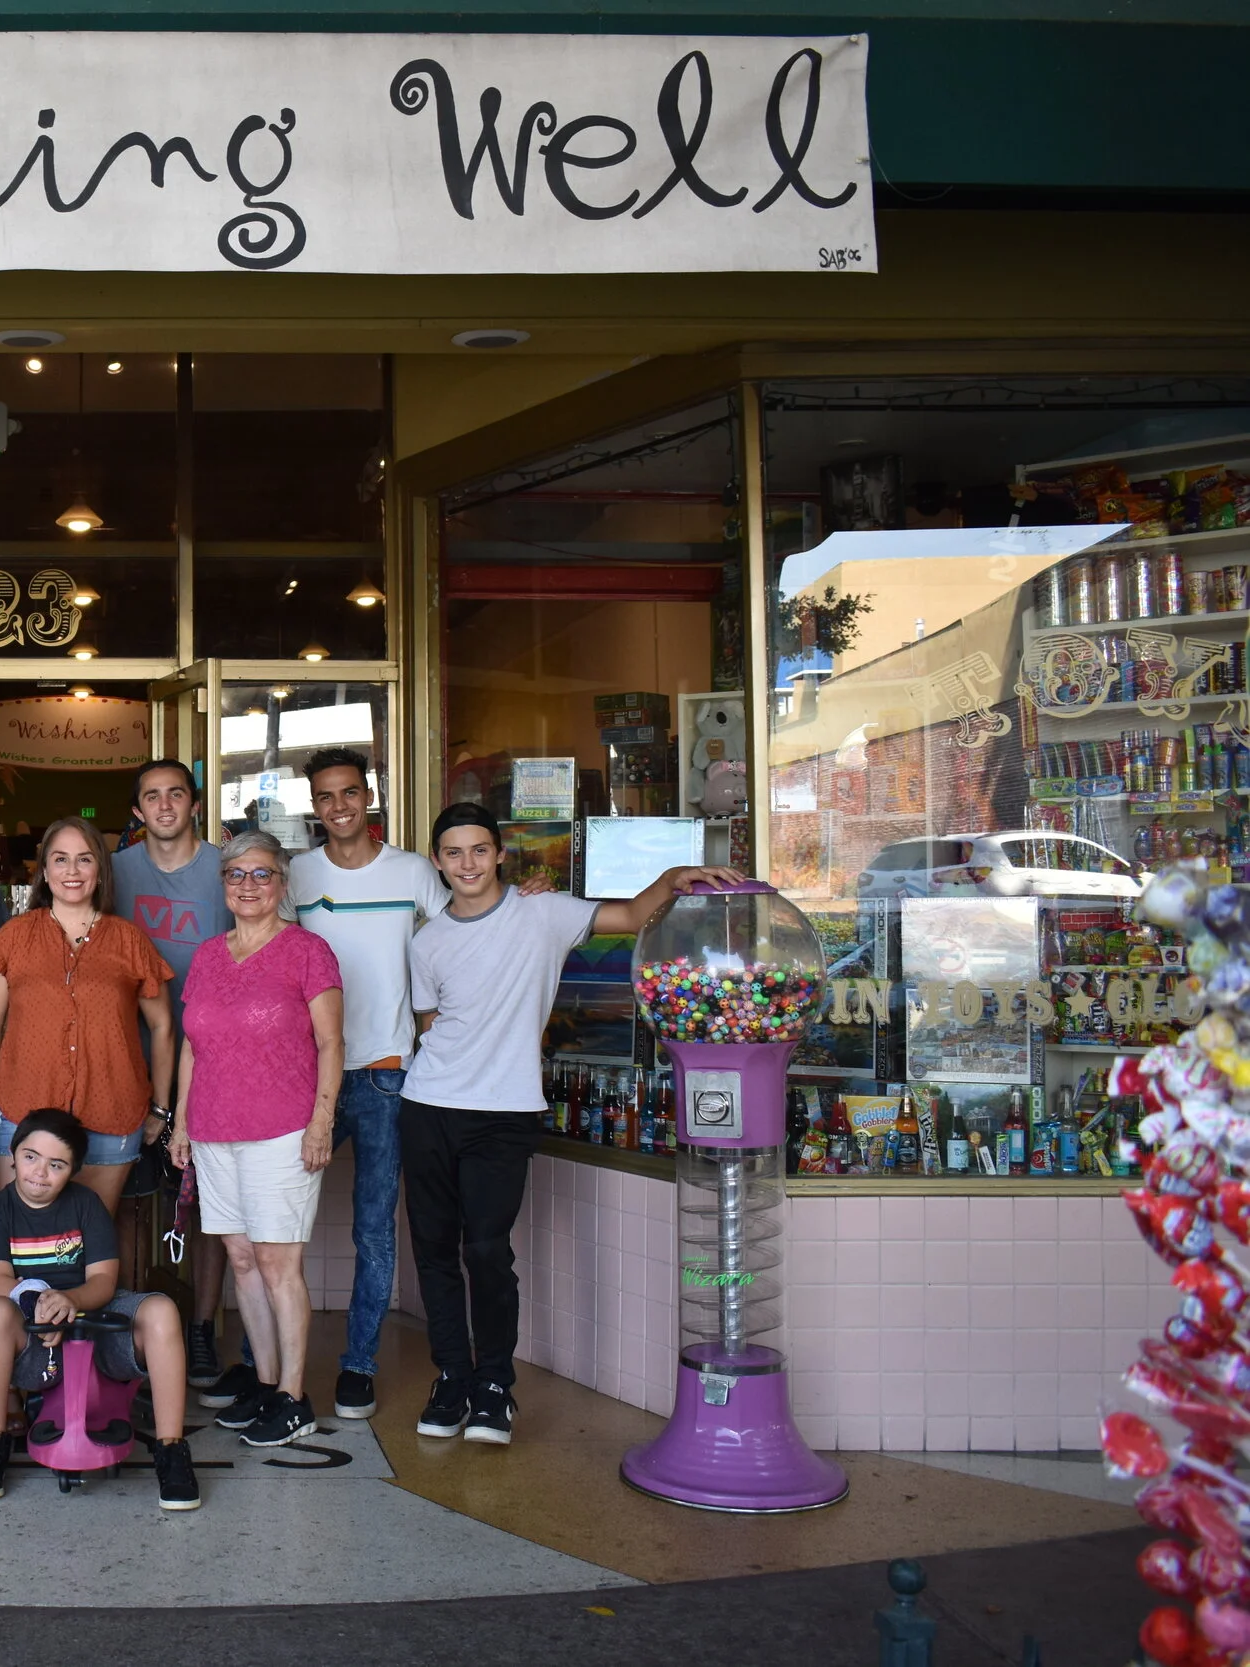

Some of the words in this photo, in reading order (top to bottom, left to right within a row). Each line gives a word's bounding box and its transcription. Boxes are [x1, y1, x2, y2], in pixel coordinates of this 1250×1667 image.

[389, 47, 857, 220] Well
[8, 717, 121, 745] Wishing
[52, 756, 113, 766] Granted
[573, 820, 581, 856] 1000
[877, 900, 886, 934] 1000
[814, 978, 891, 1025] IN
[917, 979, 1052, 1027] TOYS
[1034, 1042, 1043, 1084] PUZZLE
